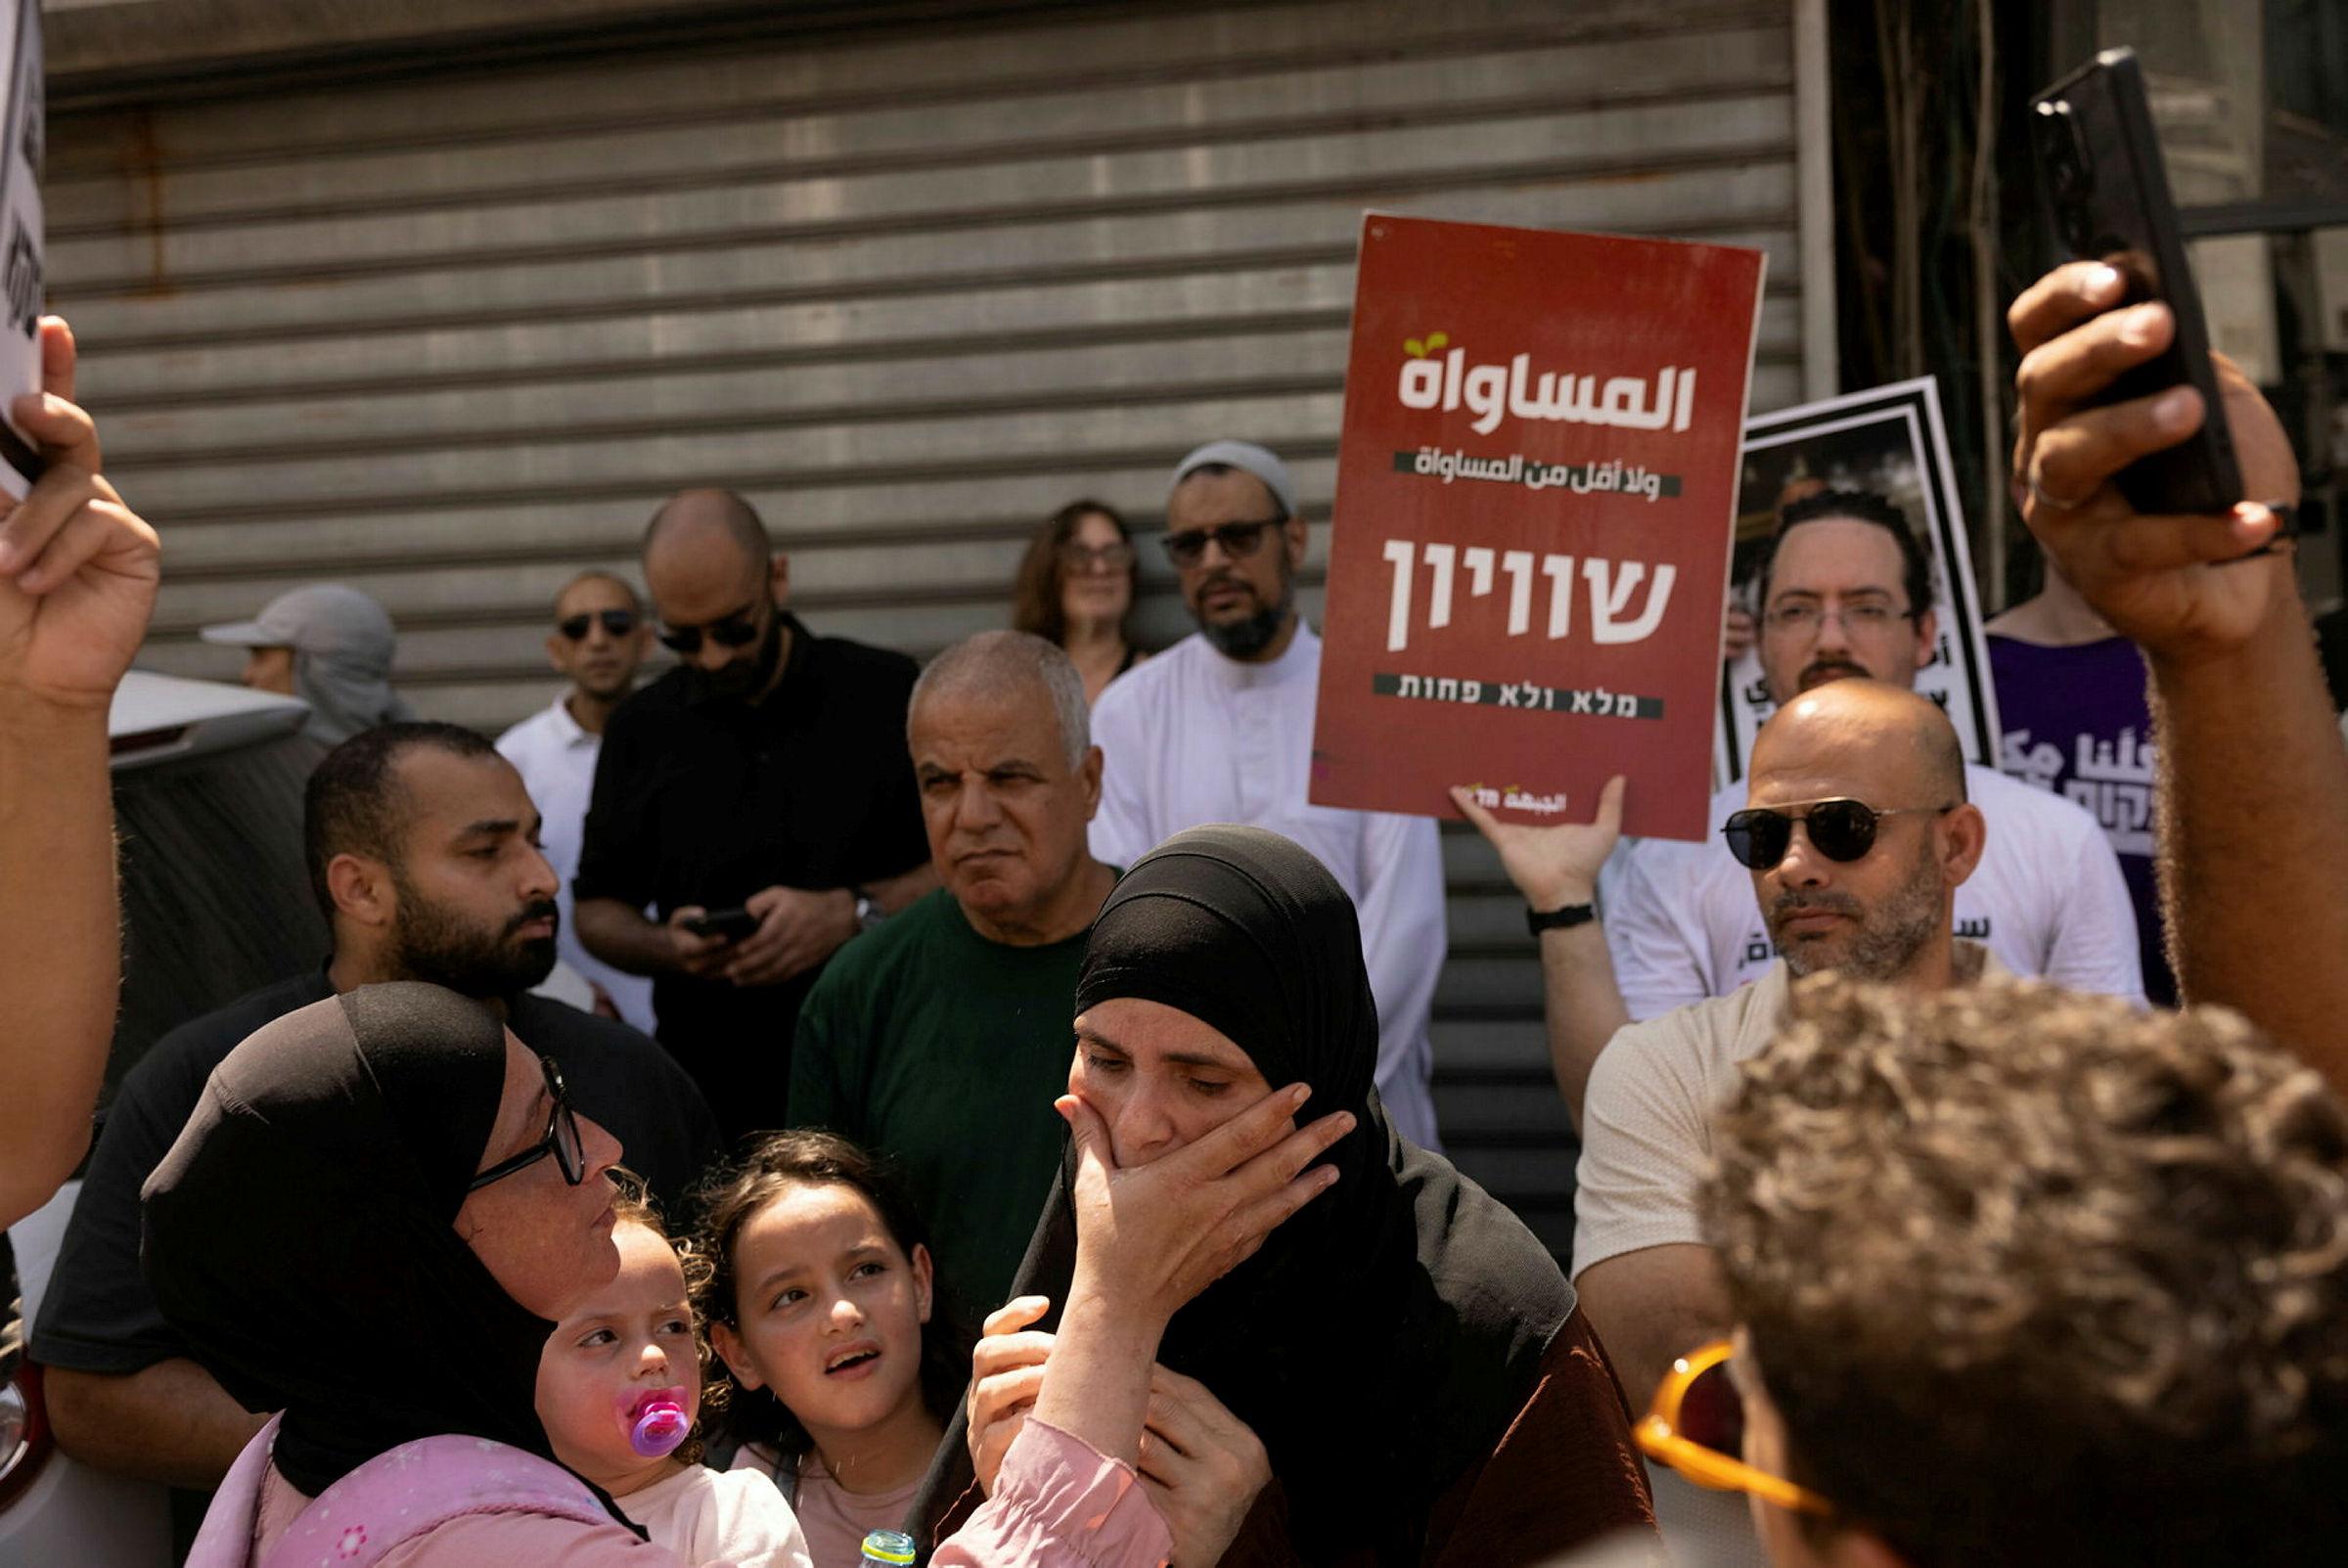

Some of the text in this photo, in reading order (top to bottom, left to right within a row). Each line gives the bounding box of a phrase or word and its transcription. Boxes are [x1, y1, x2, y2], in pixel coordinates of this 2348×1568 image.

[1397, 332, 1696, 436] المساواة
[1415, 446, 1661, 503] ولا أقل من المساواة
[1383, 539, 1678, 652] שוויון
[1396, 673, 1639, 718] מלא ולא פחות
